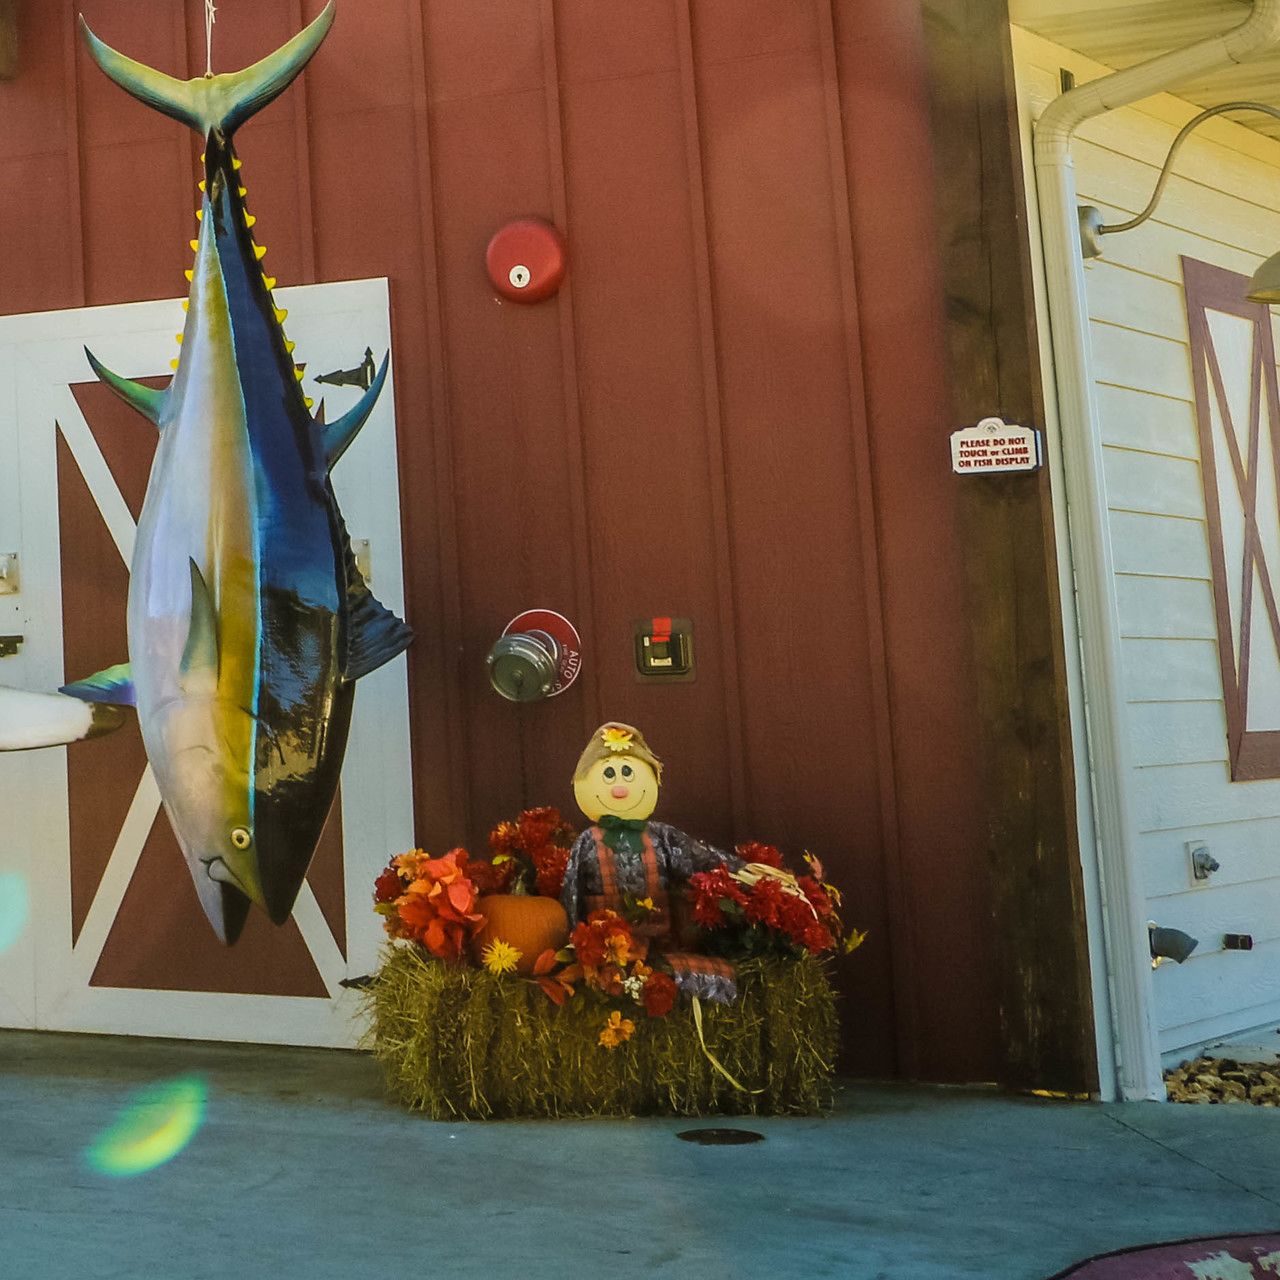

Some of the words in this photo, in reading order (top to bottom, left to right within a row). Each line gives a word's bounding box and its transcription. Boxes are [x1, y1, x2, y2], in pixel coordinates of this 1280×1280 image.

[960, 439, 990, 447] PLEASE
[1008, 437, 1026, 445] NOT
[959, 449, 987, 457] TOUCH
[1002, 447, 1028, 455] CLIMB
[958, 460, 971, 468] ON
[974, 458, 993, 467] FISH
[995, 457, 1030, 466] DISPLAY
[563, 650, 579, 679] AUTO
